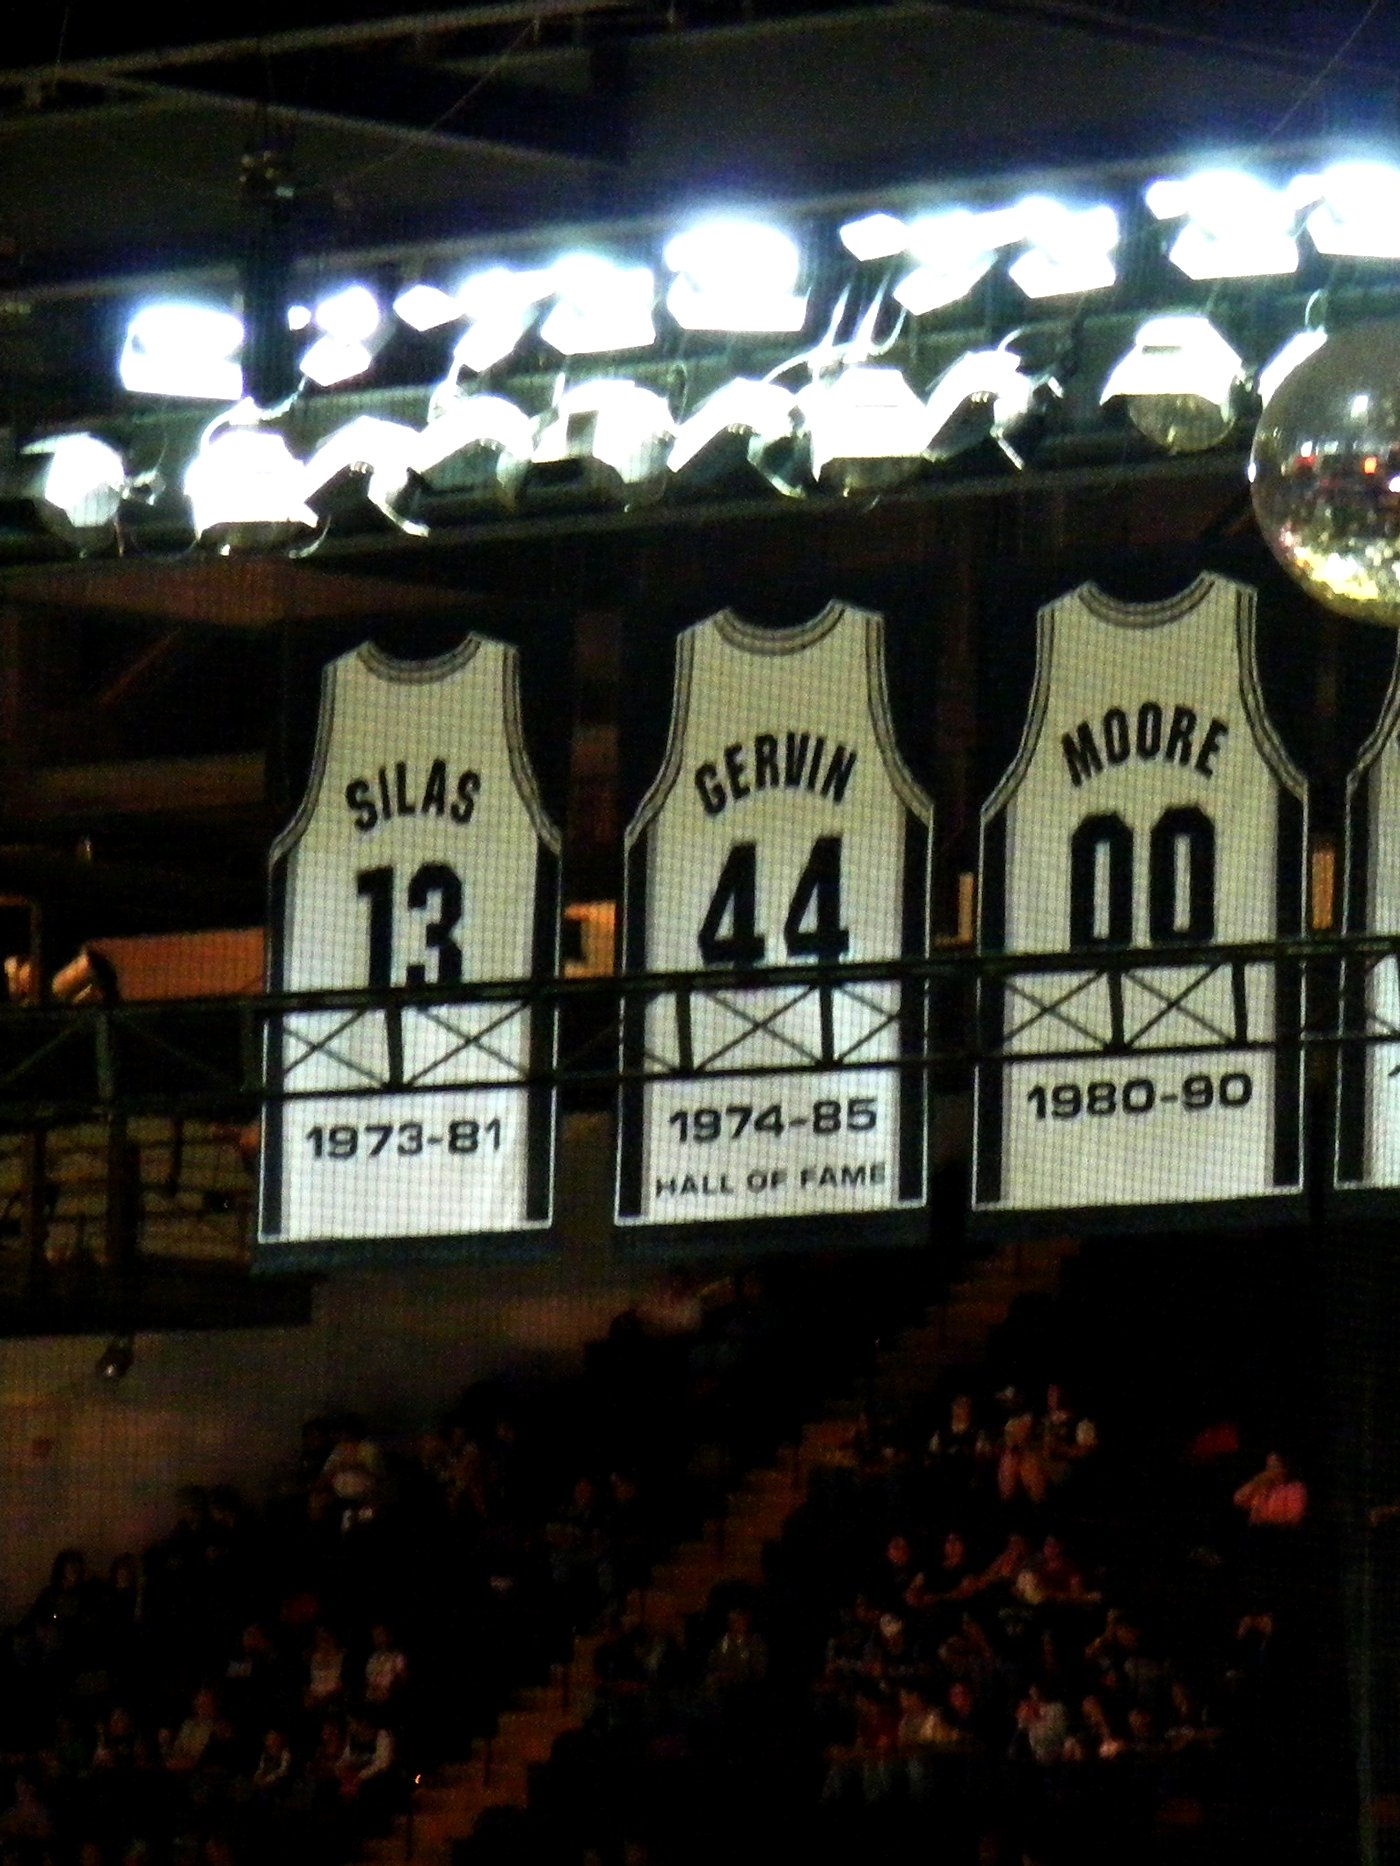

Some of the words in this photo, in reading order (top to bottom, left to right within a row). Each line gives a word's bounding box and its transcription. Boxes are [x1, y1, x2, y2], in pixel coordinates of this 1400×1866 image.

[694, 732, 856, 815] GERVIN
[1060, 701, 1229, 788] MOORE
[346, 759, 482, 832] SILAS
[698, 833, 850, 972] 44
[1069, 806, 1216, 952] 00
[355, 861, 464, 990] 13
[669, 1097, 878, 1143] 1974-85
[1027, 1072, 1254, 1120] 1980-90
[306, 1119, 502, 1159] 1973-81
[655, 1175, 735, 1198] HALL
[746, 1170, 789, 1194] OF
[799, 1162, 886, 1190] FAME
